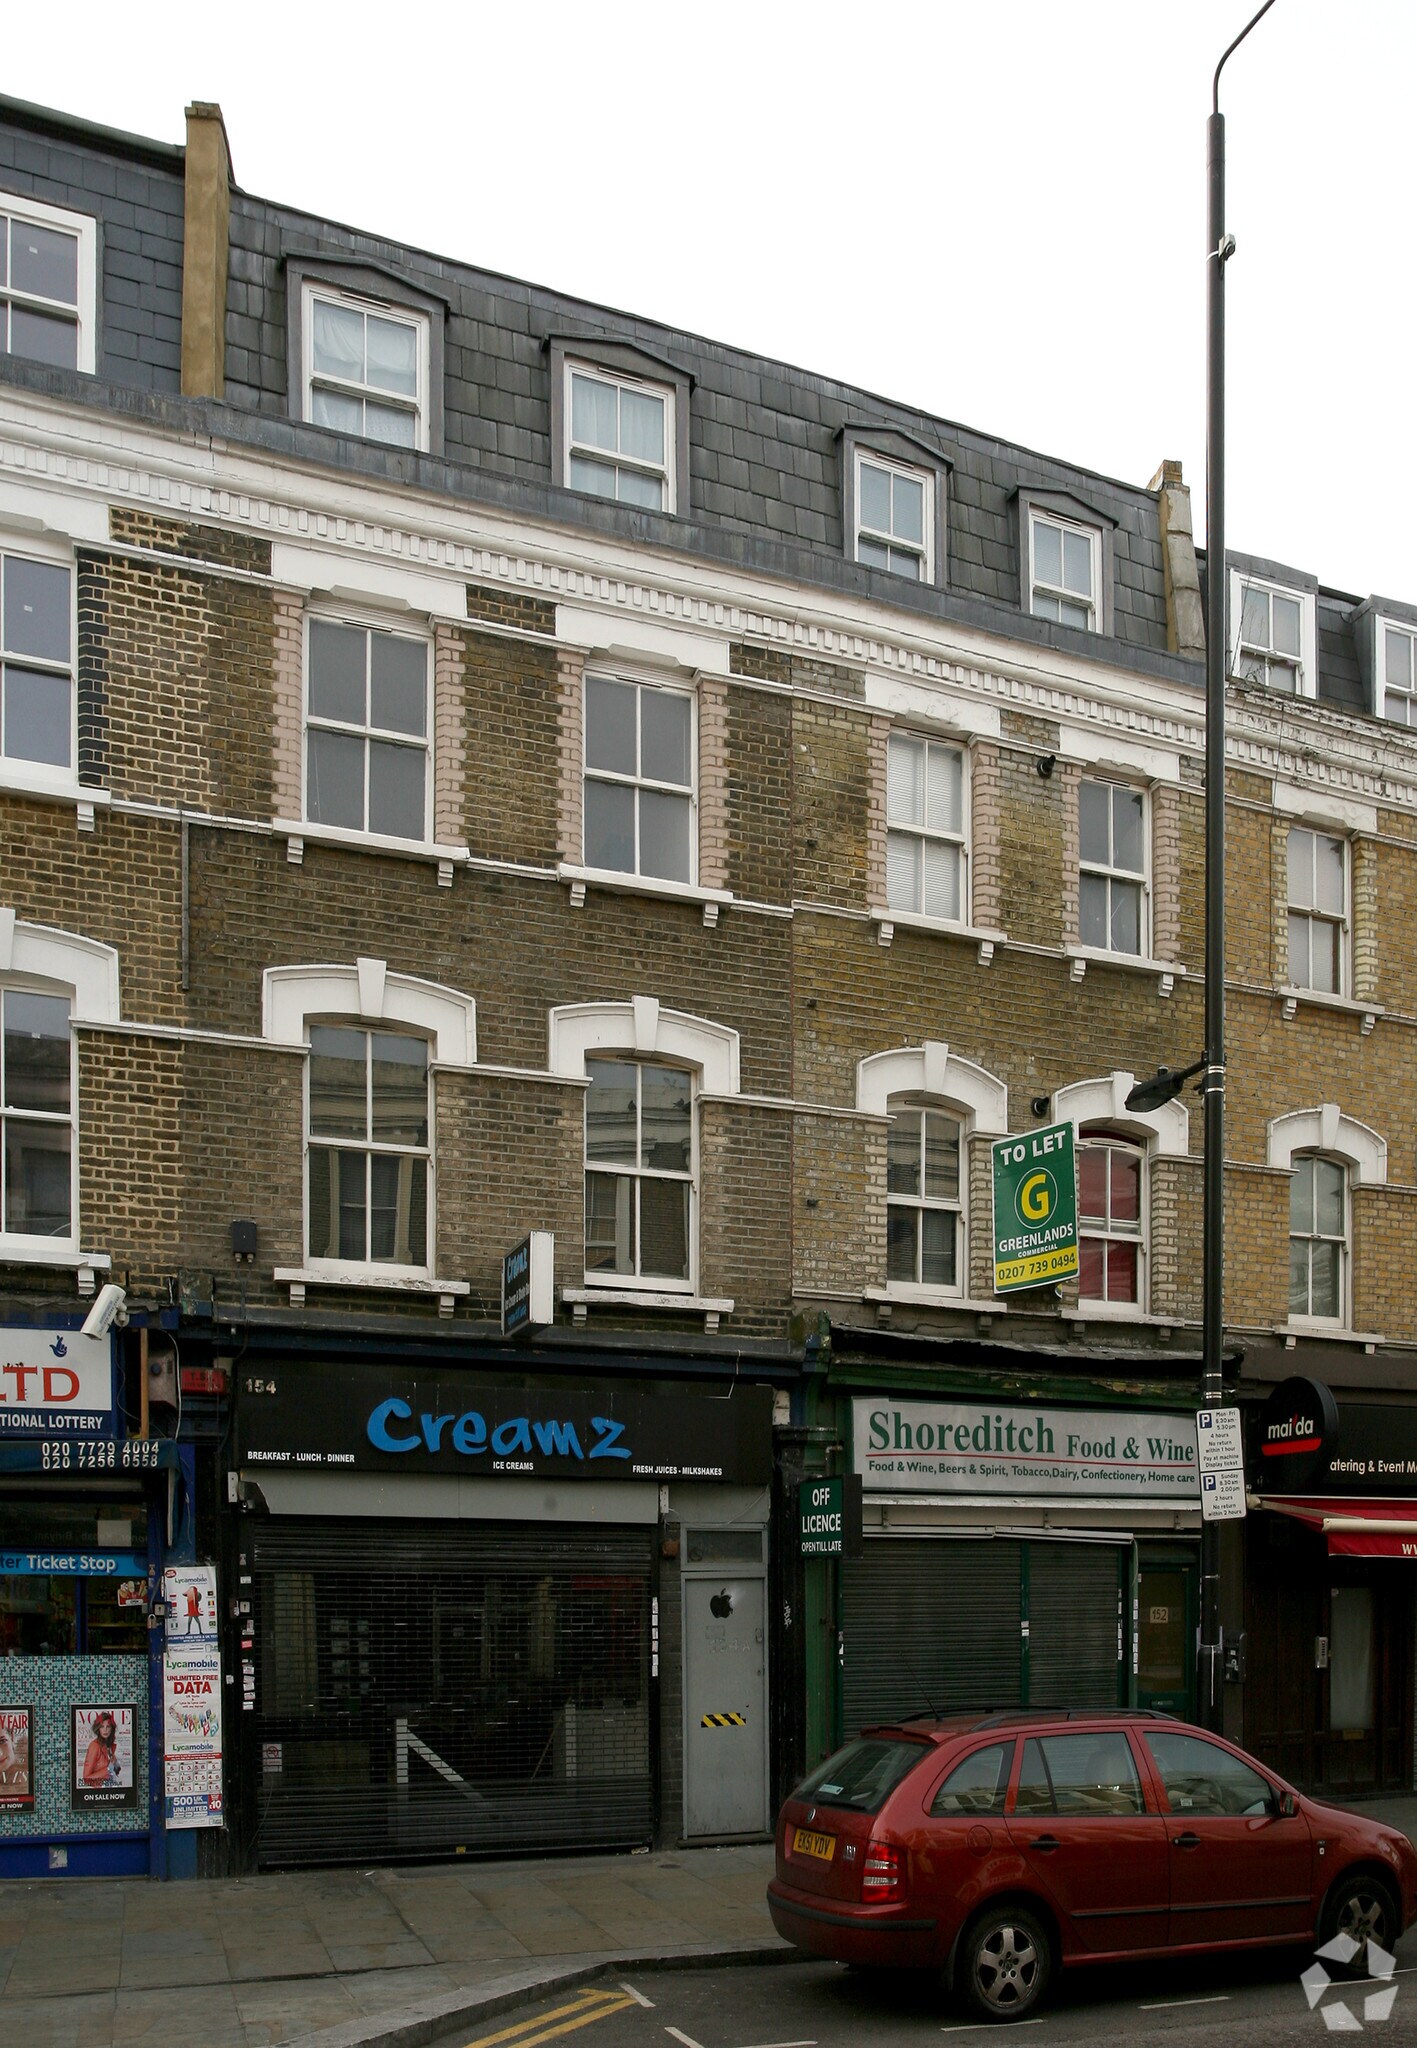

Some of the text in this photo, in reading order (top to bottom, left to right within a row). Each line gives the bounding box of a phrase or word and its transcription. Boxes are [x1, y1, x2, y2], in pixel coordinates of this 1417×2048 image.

[1000, 1130, 1066, 1166] TO LET
[1021, 1173, 1049, 1220] G
[999, 1222, 1074, 1252] GREENLANDS
[1017, 1243, 1058, 1258] COMMERCIAL
[998, 1252, 1076, 1280] 0207 739 0494
[246, 1378, 276, 1394] 154
[49, 1415, 103, 1429] LOTTERY
[1201, 1413, 1210, 1428] P
[868, 1411, 1194, 1462] Shoreditch Food & Wine
[41, 1441, 159, 1456] 020 7729 4004
[42, 1454, 158, 1470] 020 7256 0558
[247, 1451, 291, 1461] BREAKFAST
[296, 1452, 322, 1462] LUNCH
[327, 1453, 355, 1463] DINNER
[493, 1461, 534, 1471] ICE CREAMS
[632, 1464, 653, 1474] FRESH
[655, 1465, 678, 1475] JUICES
[682, 1466, 723, 1476] MILKSHAKES
[868, 1460, 894, 1472] Food
[897, 1461, 905, 1471] &
[907, 1462, 937, 1475] Wine,
[938, 1463, 967, 1474] Beers
[969, 1463, 977, 1474] &
[979, 1464, 1009, 1477] Spirit,
[1081, 1468, 1146, 1483] Confectionery,
[1148, 1472, 1175, 1482] Home
[1176, 1474, 1195, 1483] care
[1367, 1460, 1375, 1472] &
[1378, 1460, 1405, 1473] Event
[1406, 1460, 1417, 1473] M
[1205, 1476, 1214, 1490] P
[812, 1487, 830, 1506] OFF
[802, 1513, 841, 1533] LICENCE
[827, 1540, 842, 1551] LATE
[26, 1554, 76, 1570] Ticket
[80, 1555, 116, 1573] Stop
[174, 1575, 207, 1584] Lycamobile
[1152, 1608, 1167, 1621] 152
[166, 1659, 219, 1670] Lycamobile
[166, 1674, 201, 1682] UNLIMITED
[173, 1681, 212, 1695] DATA
[7, 1714, 29, 1729] FAIR
[172, 1743, 214, 1752] Lycamobile
[173, 1796, 193, 1806] 500
